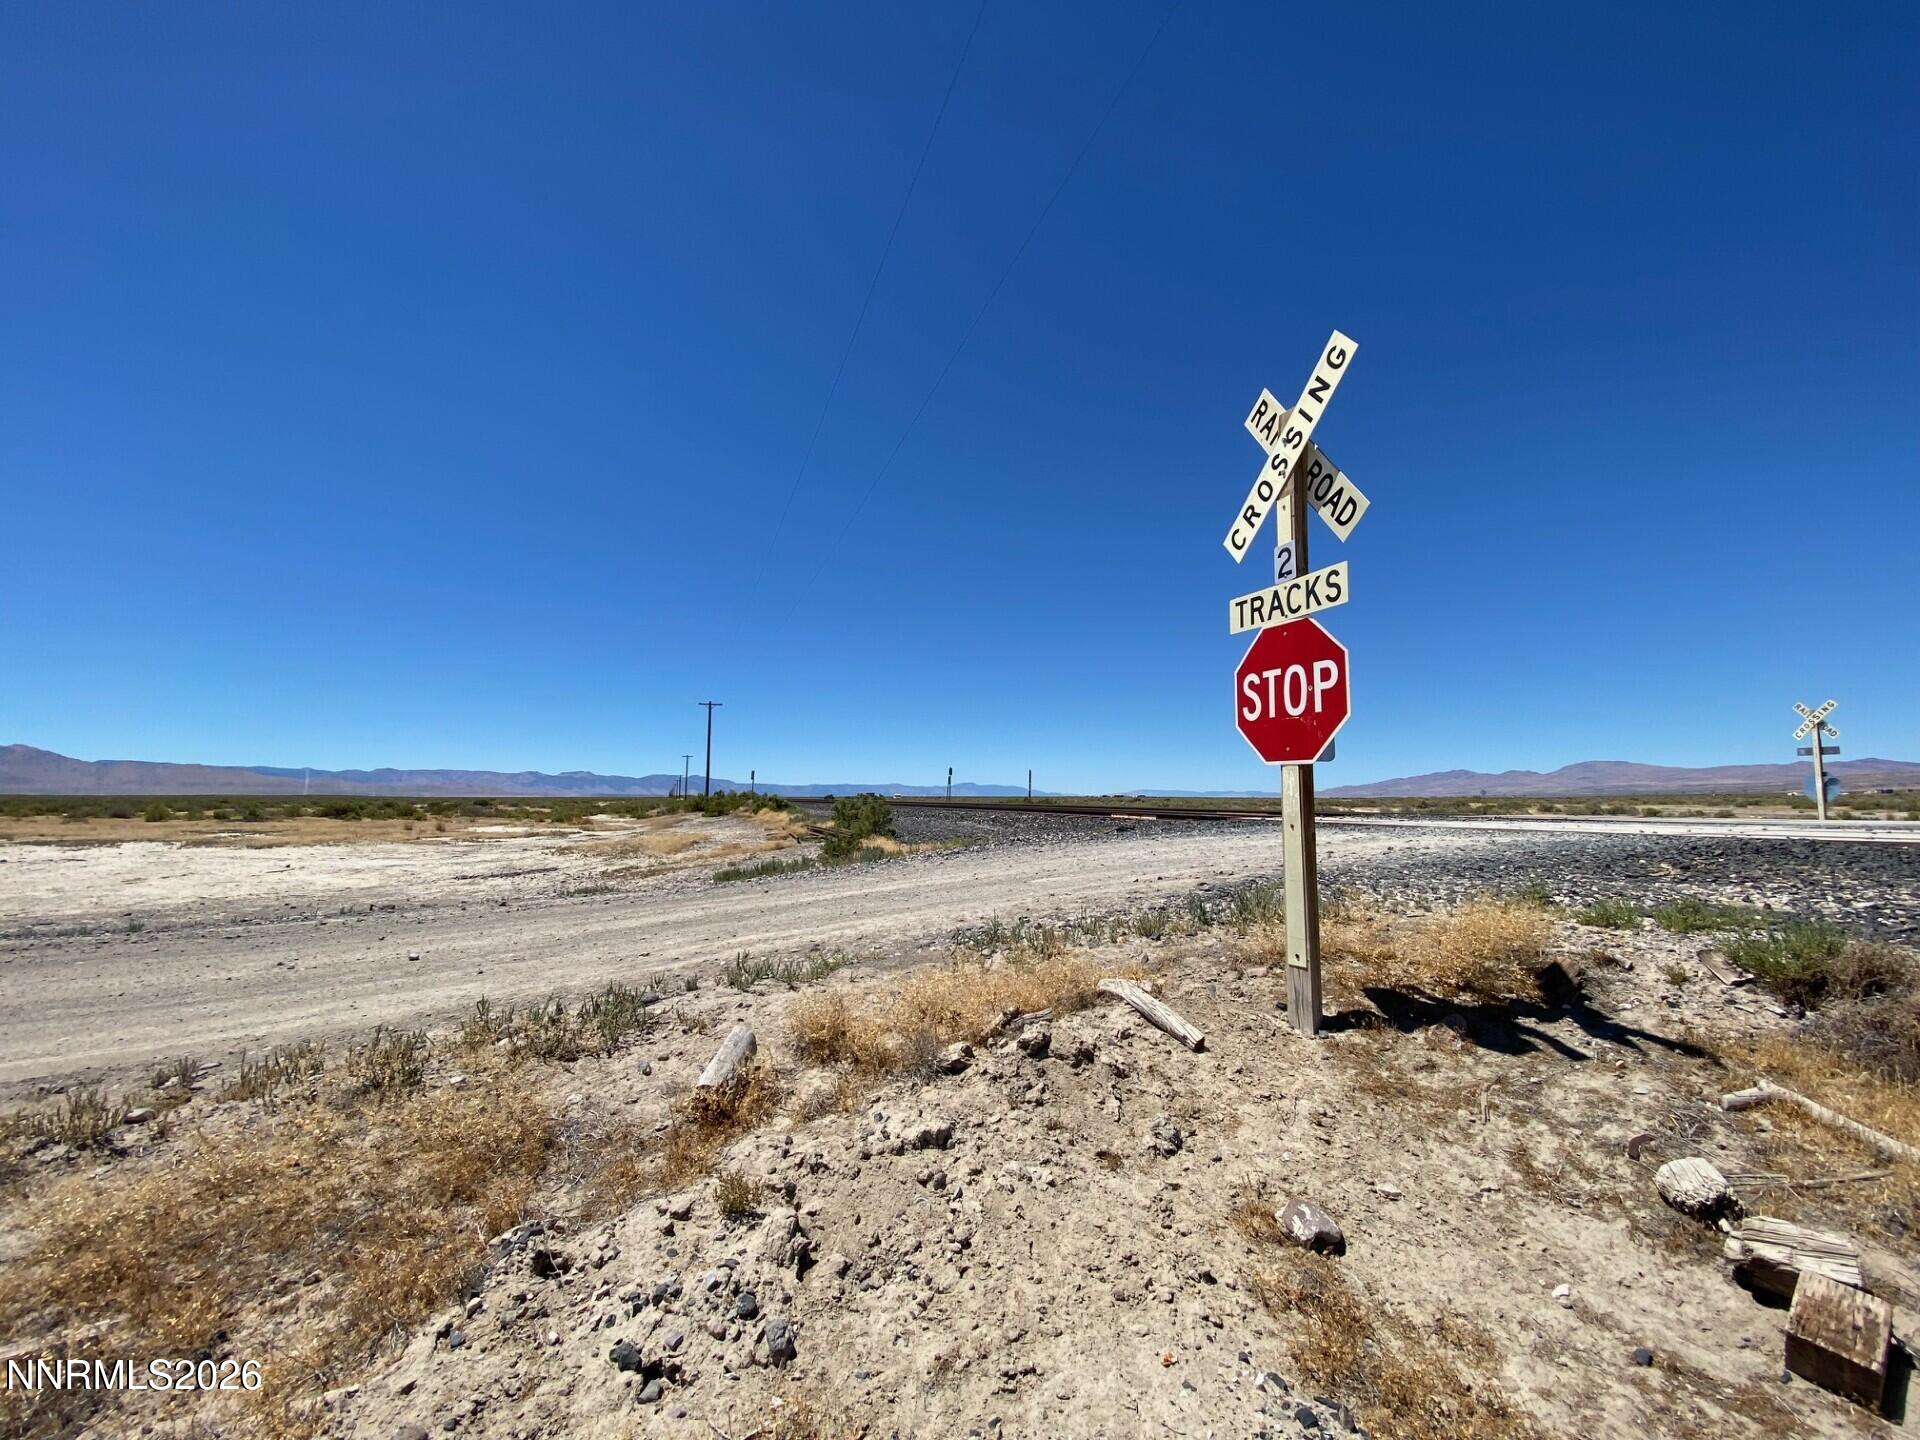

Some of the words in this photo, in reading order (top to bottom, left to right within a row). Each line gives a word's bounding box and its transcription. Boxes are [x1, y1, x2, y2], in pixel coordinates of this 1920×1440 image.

[1231, 345, 1346, 550] CROSSING
[1251, 399, 1357, 527] RAIROAD
[1277, 547, 1292, 579] 2
[1235, 569, 1341, 628] TRACKS
[1242, 659, 1339, 722] STOP
[1795, 701, 1835, 738] CROSSING
